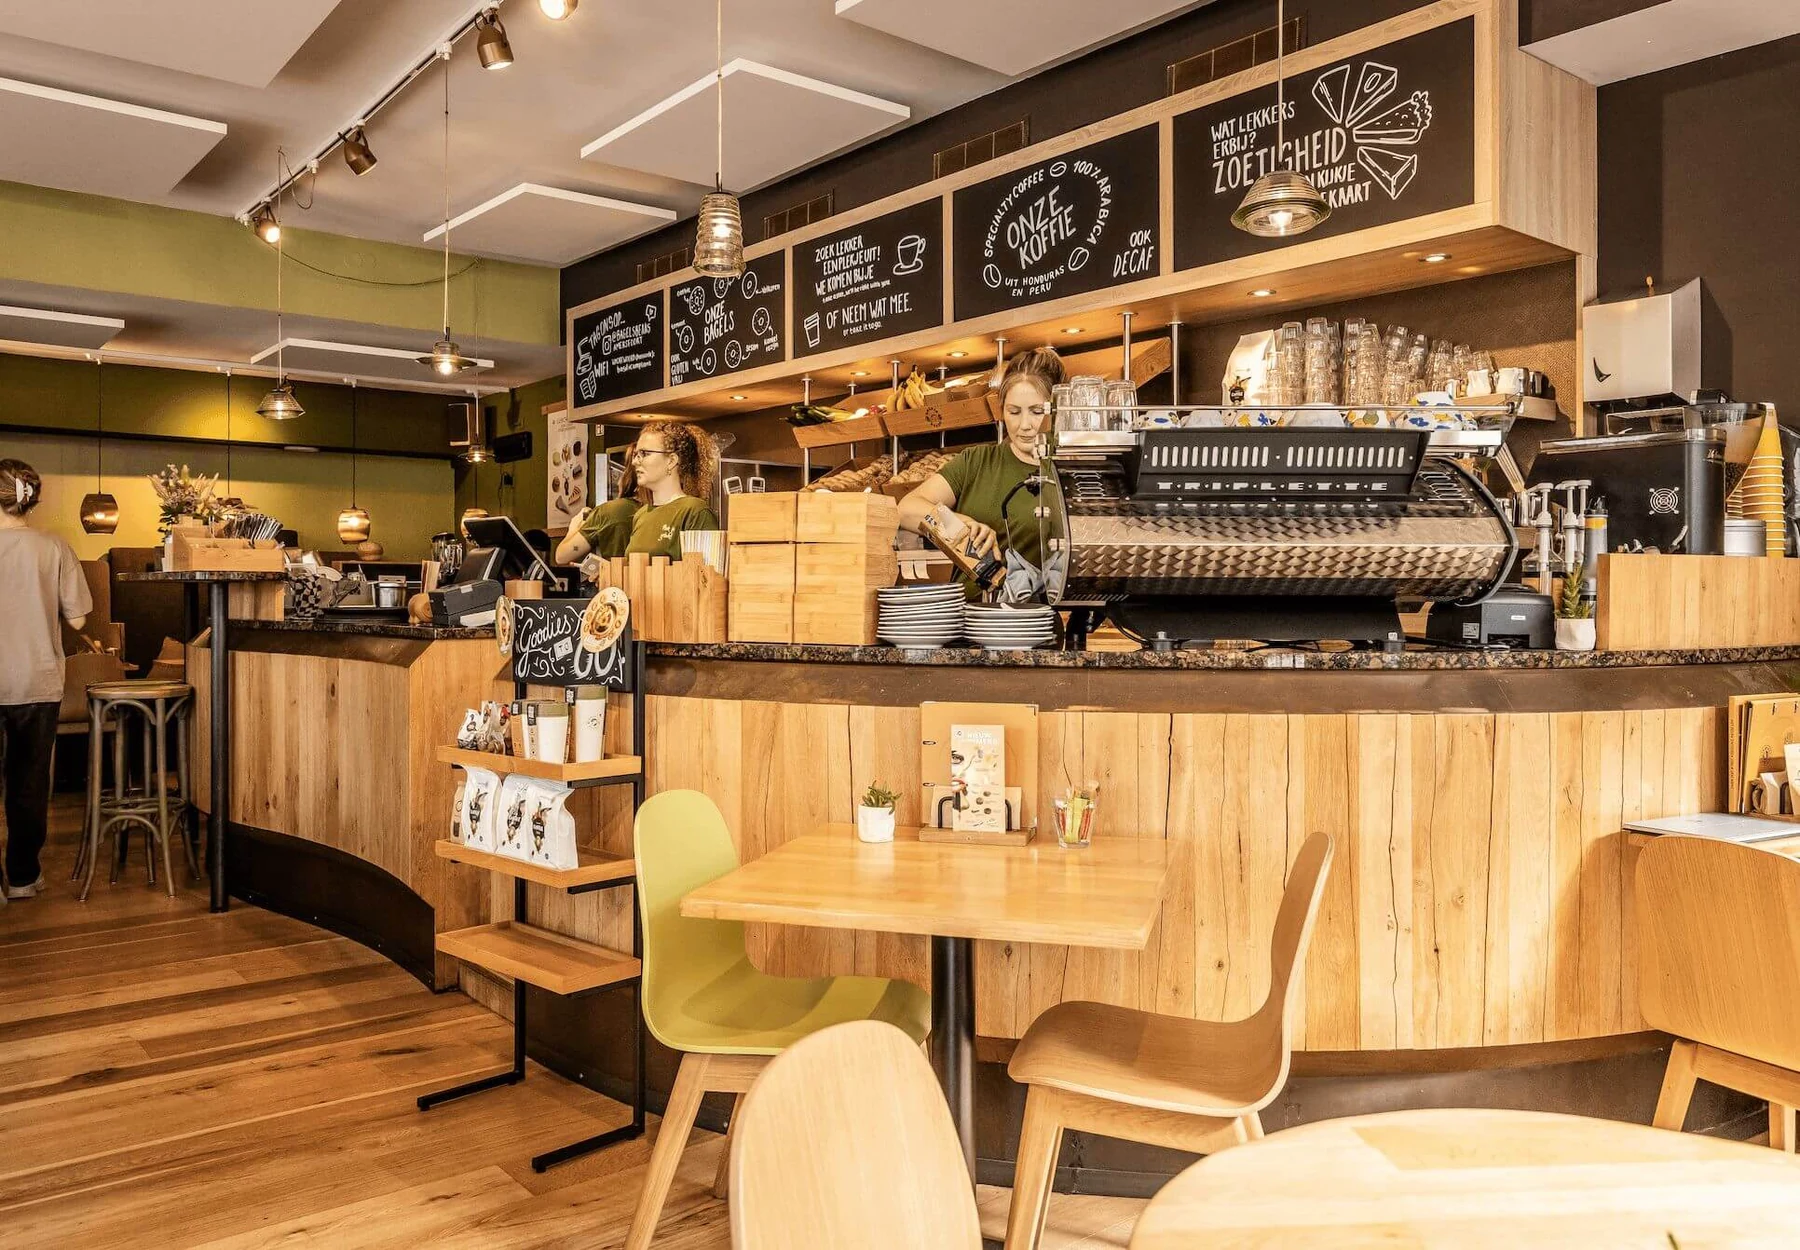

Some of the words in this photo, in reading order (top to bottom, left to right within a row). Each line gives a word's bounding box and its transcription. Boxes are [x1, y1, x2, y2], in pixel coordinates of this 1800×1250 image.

[1210, 119, 1236, 142] WAT
[1239, 101, 1296, 132] LEKKERS
[1213, 131, 1257, 160] ERBIJ?
[1212, 127, 1348, 194] ZOETIGHEID
[1317, 162, 1356, 187] KIJKJE
[1073, 160, 1101, 178] 100%
[1087, 176, 1112, 245] ARABICA
[1327, 181, 1372, 208] KAART
[984, 194, 1014, 257] SPECIALTY
[1012, 169, 1045, 198] COFFEE
[1006, 185, 1064, 249] ONZE
[815, 246, 835, 263] ZOEK
[836, 235, 864, 256] LEKKER
[1019, 204, 1077, 270] KOFFIE
[1129, 229, 1152, 248] OOK
[823, 257, 838, 276] EEN
[838, 250, 864, 270] PLEKJE
[864, 245, 881, 263] UIT!
[1112, 246, 1155, 278] DECAF
[815, 280, 827, 297] WE
[827, 271, 853, 293] KOMEN
[1004, 278, 1019, 287] UIT
[1022, 265, 1065, 285] HONDURAS
[1011, 288, 1024, 297] EN
[1029, 282, 1052, 296] PERU
[704, 300, 725, 325] ONZE
[826, 310, 839, 330] OF
[842, 302, 867, 325] NEEM
[869, 297, 887, 319] WAT
[889, 292, 913, 315] MEE.
[600, 315, 613, 337] ONS
[704, 310, 735, 345] BAGELS
[842, 328, 849, 337] or
[849, 325, 863, 334] take
[593, 361, 609, 378] WIFI
[517, 611, 573, 678] Goodies
